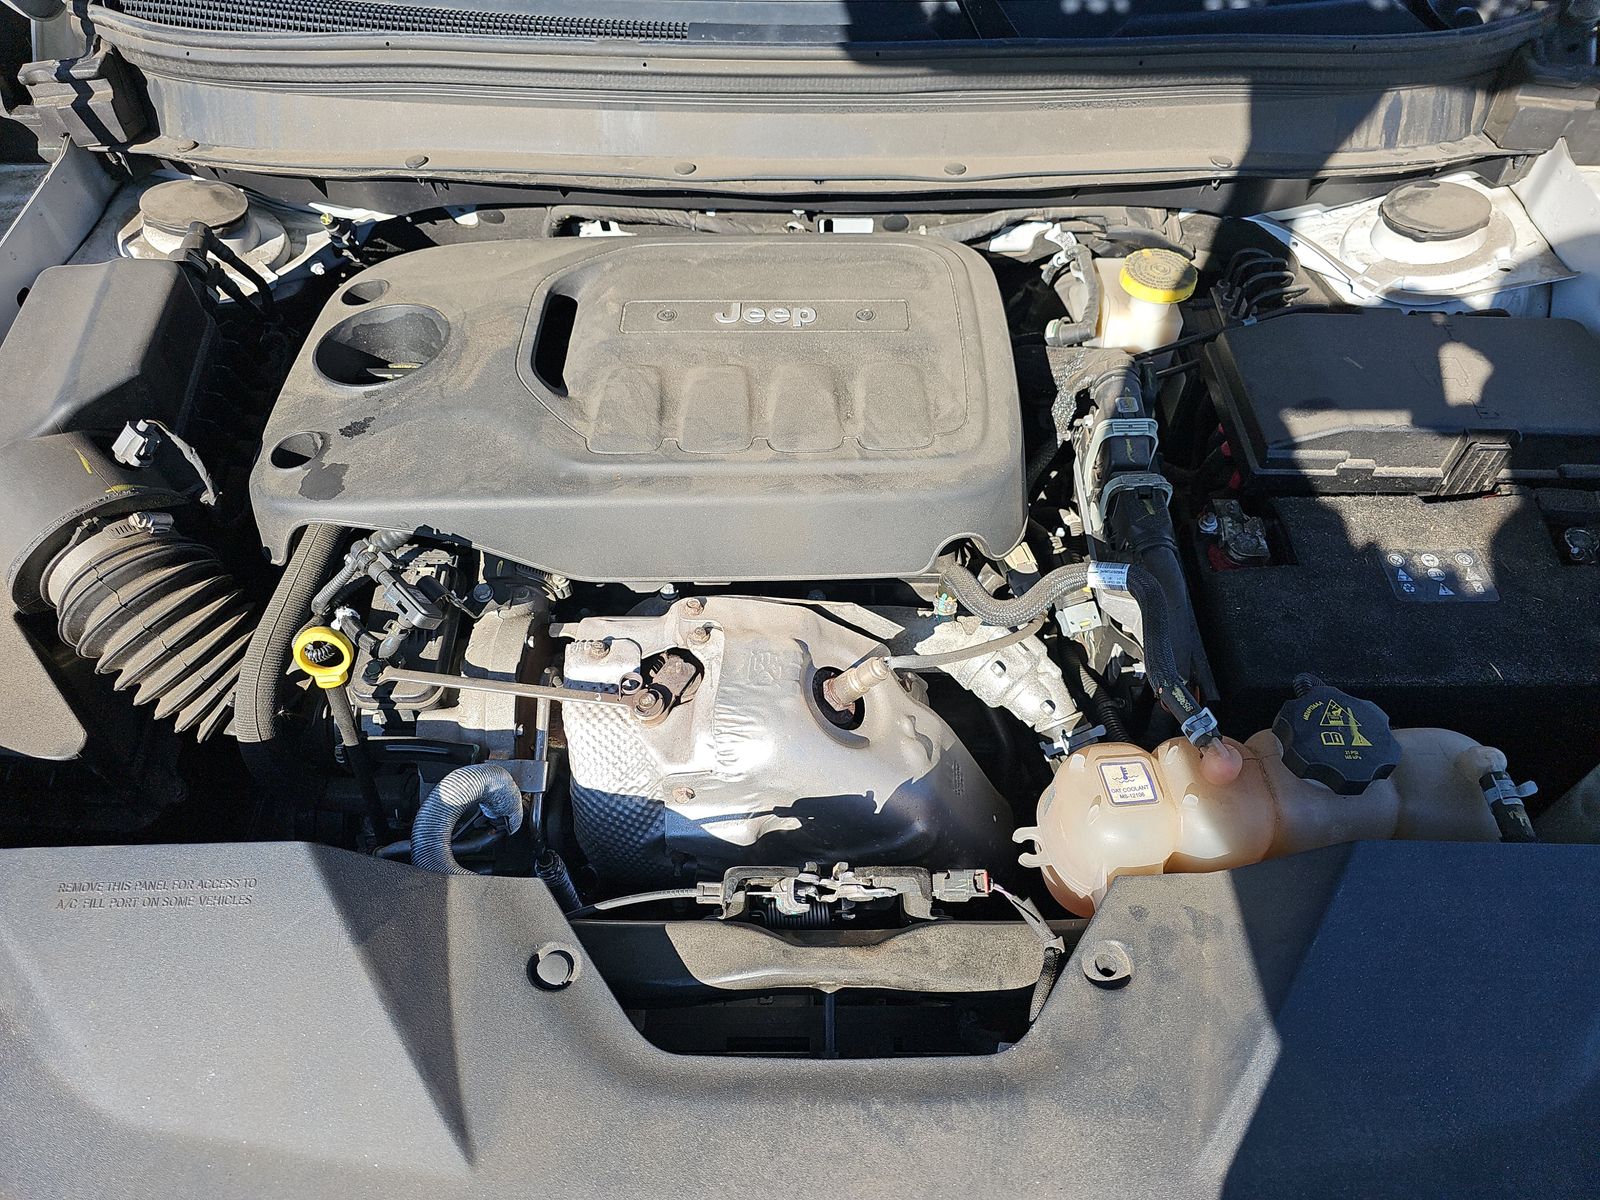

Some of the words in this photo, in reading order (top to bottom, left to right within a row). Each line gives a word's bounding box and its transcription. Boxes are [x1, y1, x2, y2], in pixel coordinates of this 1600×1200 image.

[715, 302, 818, 327] Jeep
[1122, 784, 1149, 793] COOLANT
[58, 882, 104, 893] REMOVE
[106, 881, 132, 891] THIS
[134, 880, 168, 891] PANEL
[172, 879, 194, 890] FOR
[197, 878, 240, 889] ACCESS
[243, 877, 258, 888] TO
[56, 897, 78, 910] A/C
[83, 898, 105, 909] FILL
[109, 897, 140, 908] PORT
[142, 896, 160, 907] ON
[162, 896, 195, 907] SOME
[199, 894, 253, 906] VEHICLES
